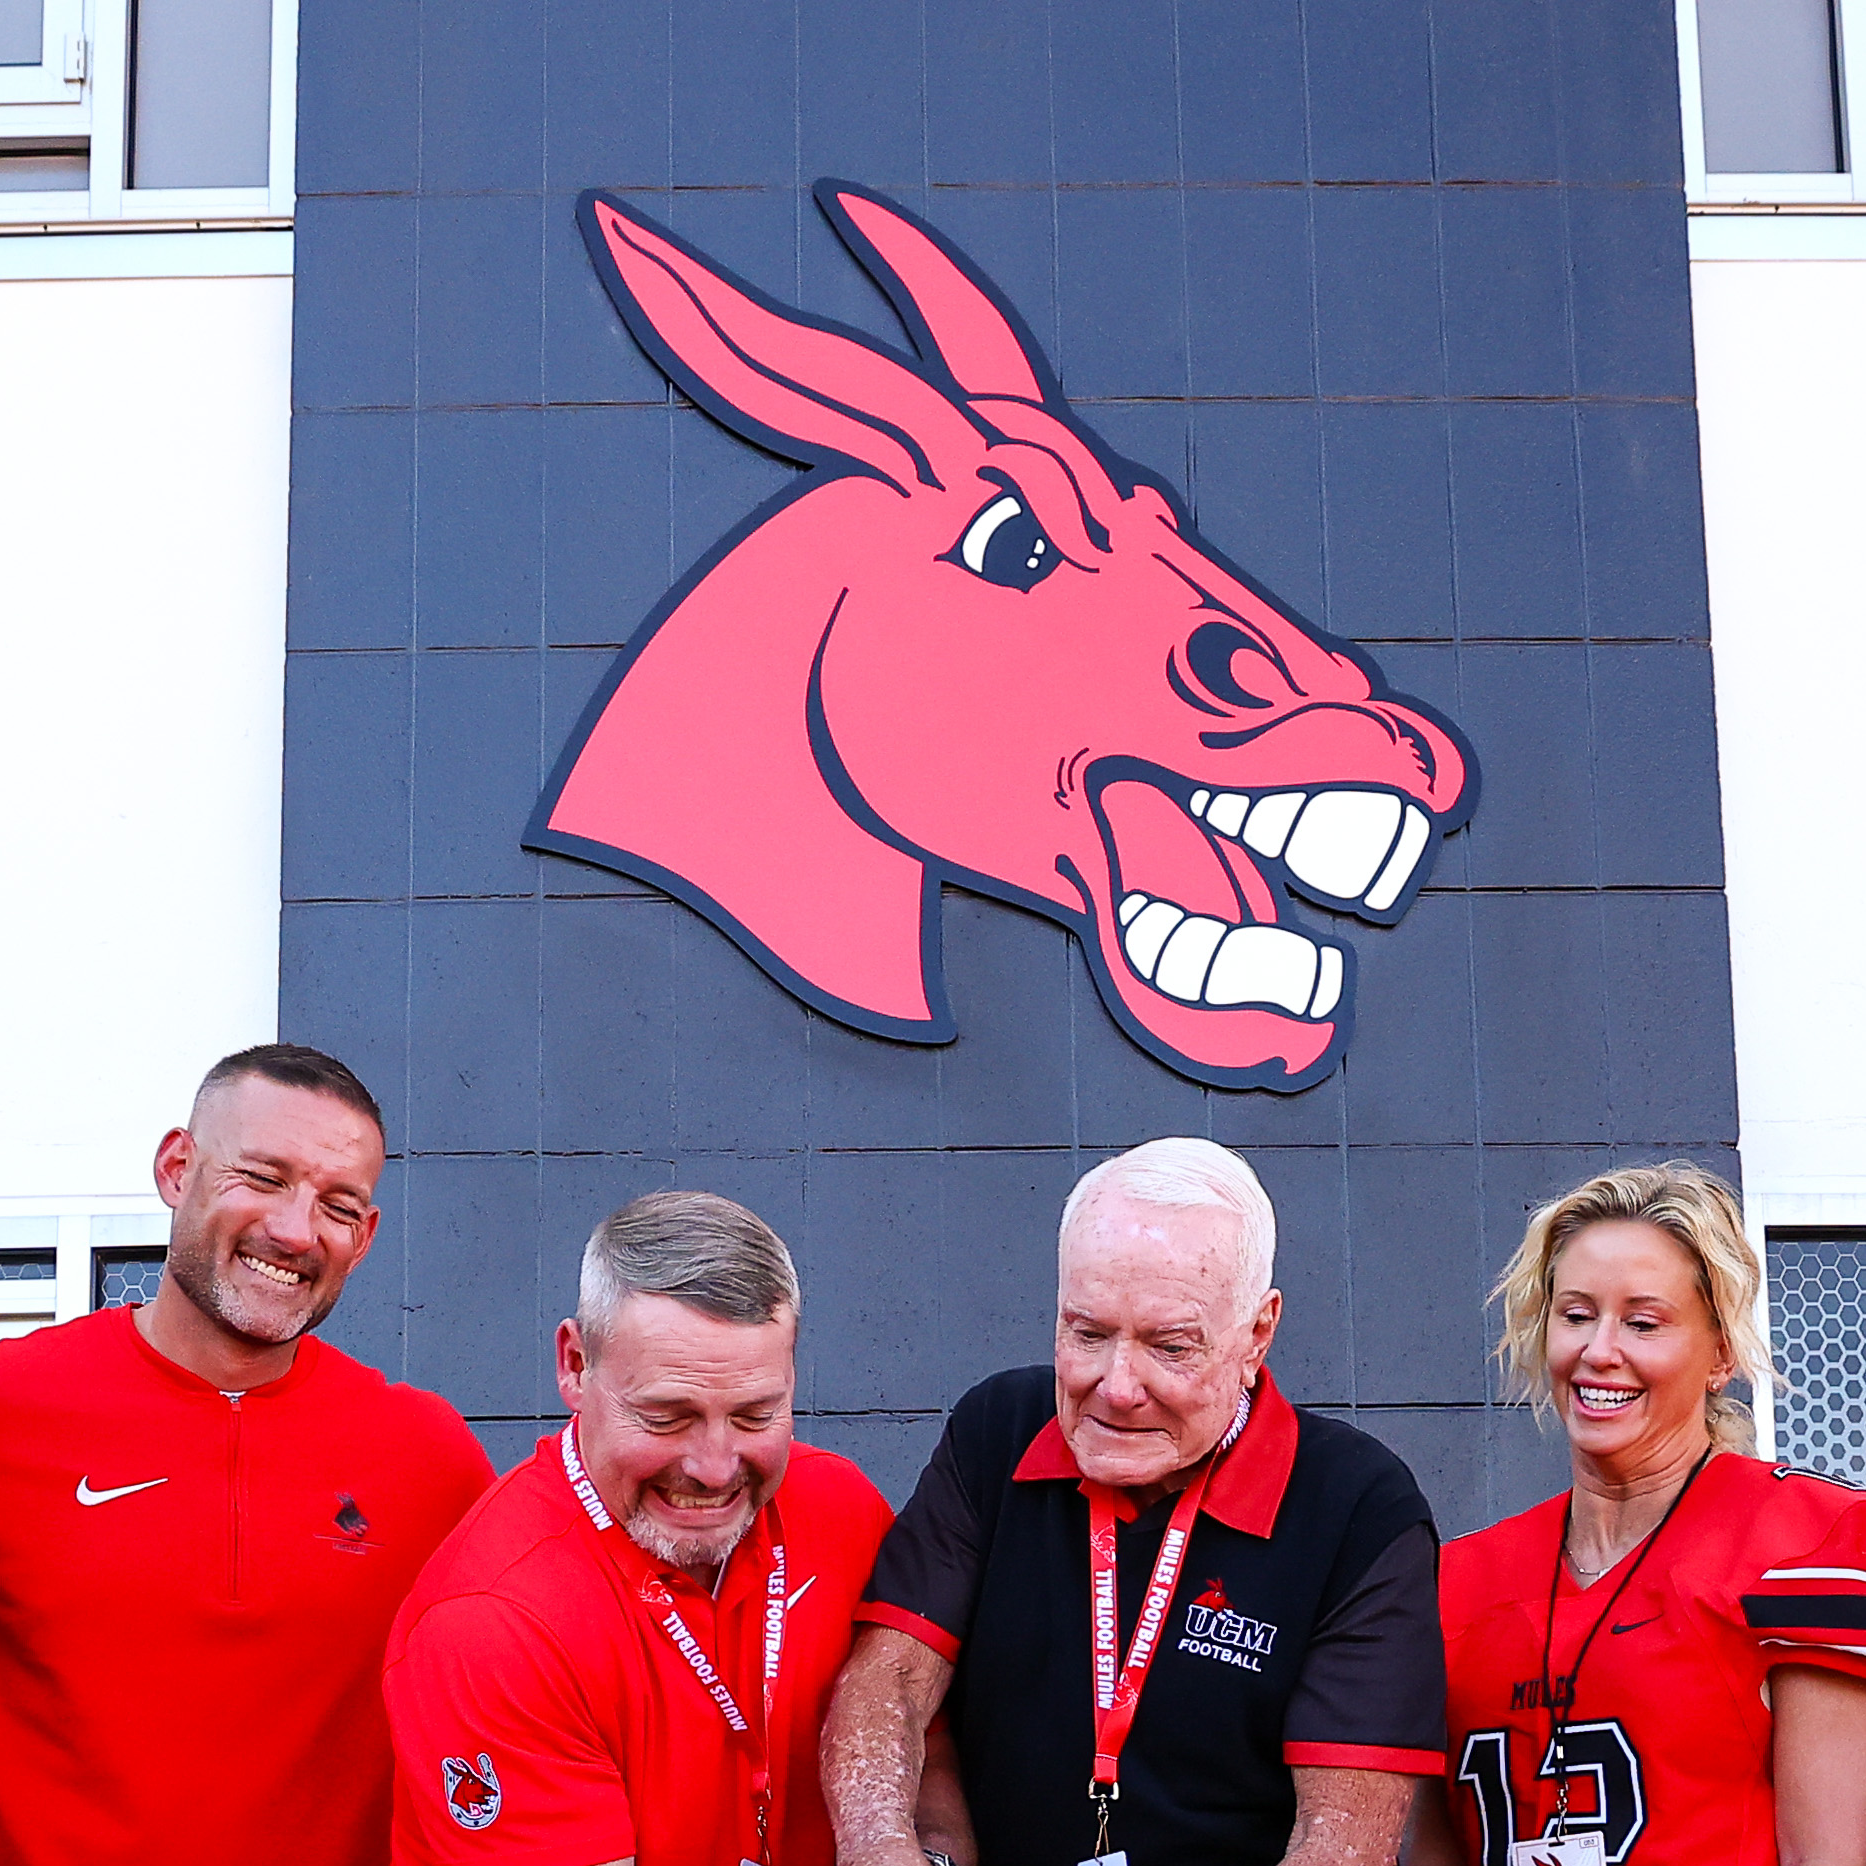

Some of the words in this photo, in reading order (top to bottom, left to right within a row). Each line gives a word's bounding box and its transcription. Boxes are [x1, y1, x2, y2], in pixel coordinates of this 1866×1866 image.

[573, 1480, 614, 1531] MULES
[1154, 1528, 1186, 1585] MULES
[1096, 1569, 1115, 1650] FOOTBALL
[1127, 1586, 1169, 1668] FOOTBALL
[1185, 1604, 1278, 1655] UCM
[662, 1610, 719, 1685] FOOTBALL
[765, 1599, 784, 1679] FOOTBALL
[1177, 1638, 1262, 1673] FOOTBALL
[709, 1683, 749, 1732] MULES
[1097, 1654, 1115, 1710] MULES
